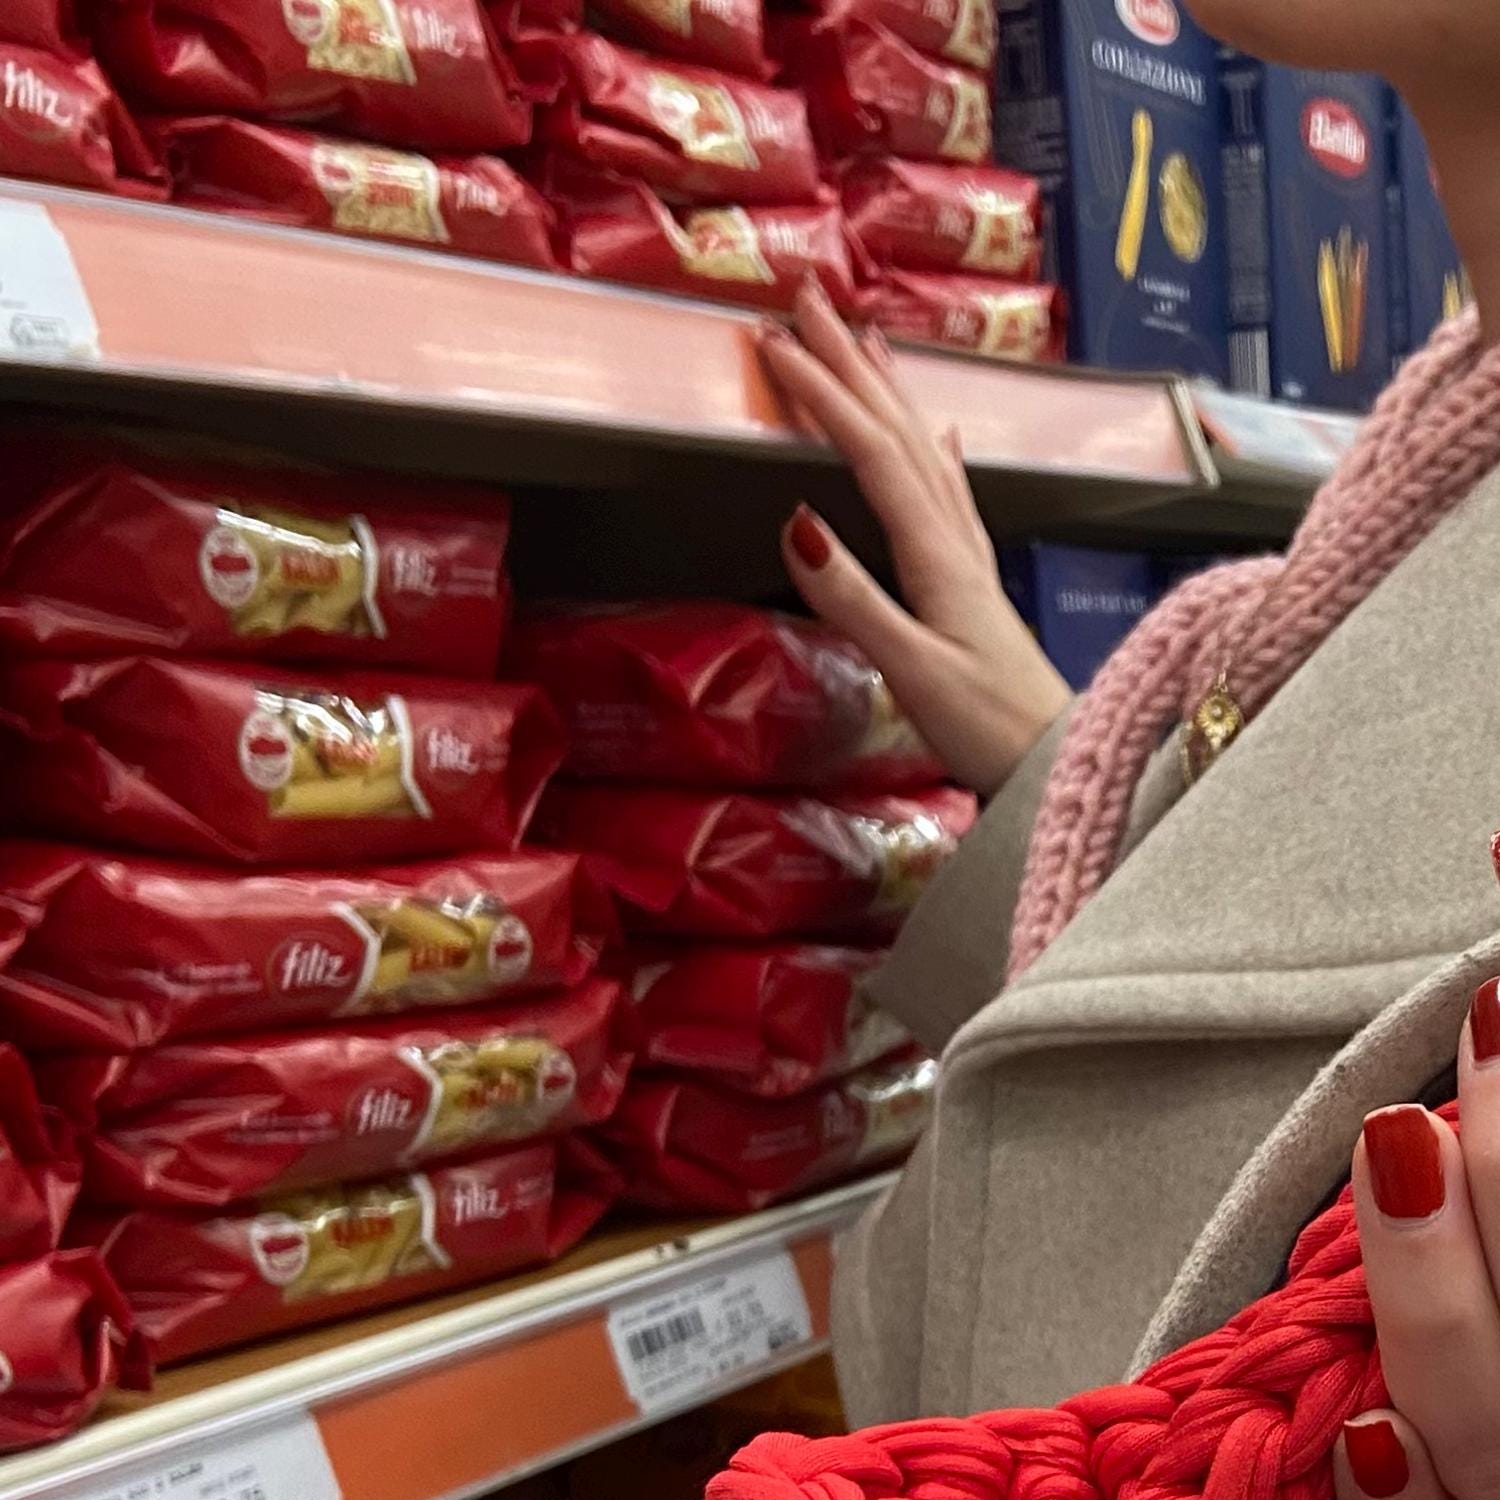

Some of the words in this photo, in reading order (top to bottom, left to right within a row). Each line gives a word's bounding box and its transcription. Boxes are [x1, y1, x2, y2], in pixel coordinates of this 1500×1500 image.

[280, 940, 353, 990] filiz
[356, 1088, 415, 1136] filiz
[453, 1179, 508, 1227] filiz
